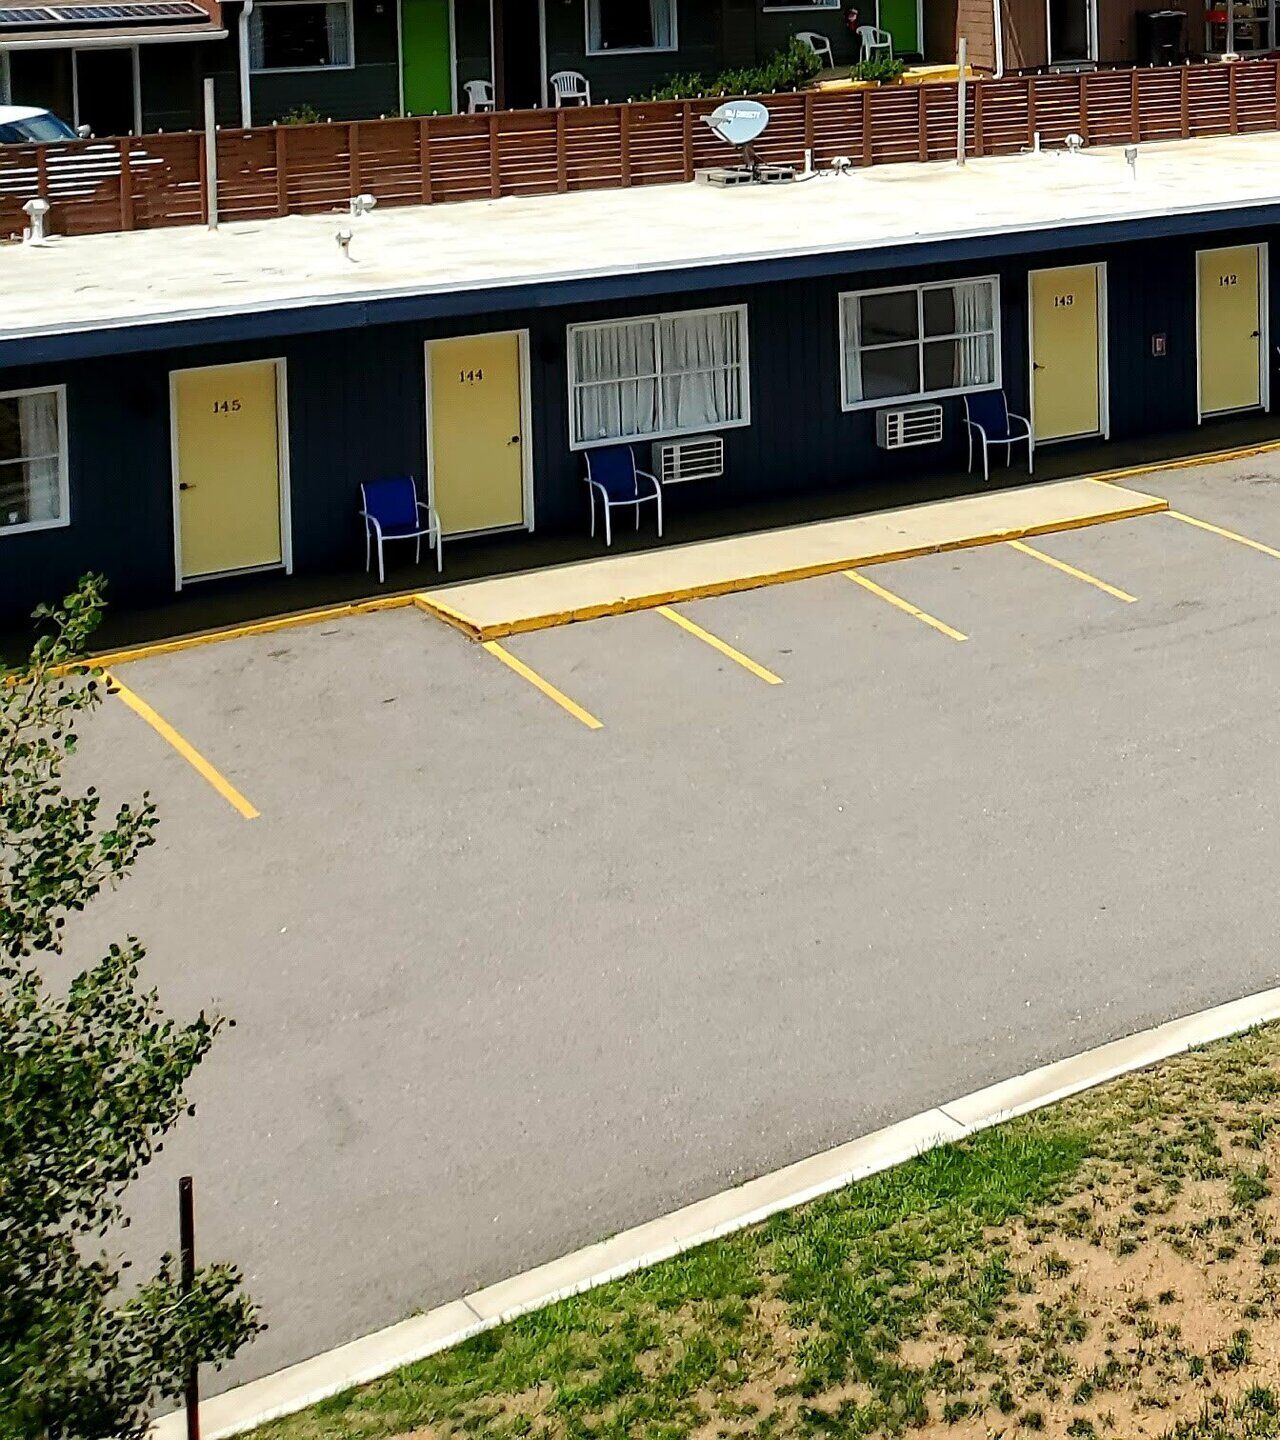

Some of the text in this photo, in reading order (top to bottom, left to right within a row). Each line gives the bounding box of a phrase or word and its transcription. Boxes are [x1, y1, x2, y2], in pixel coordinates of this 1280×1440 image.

[1219, 274, 1237, 287] 142
[1054, 294, 1073, 307] 143
[460, 368, 483, 382] 144
[213, 399, 242, 413] 145
